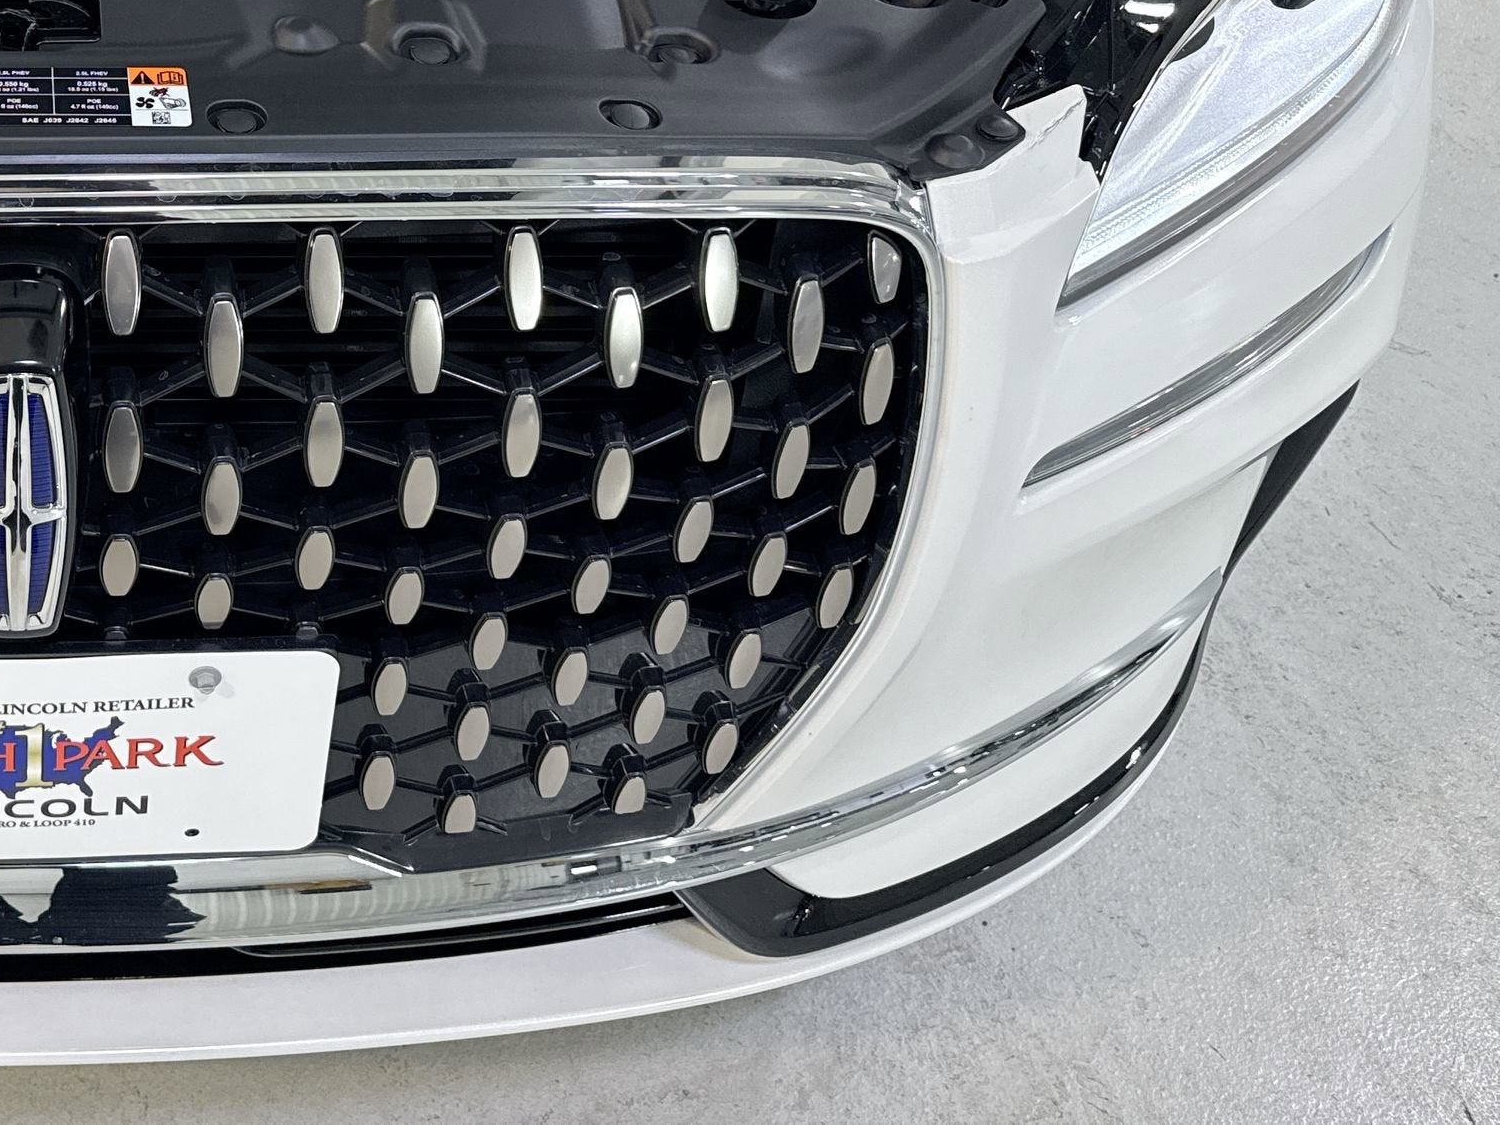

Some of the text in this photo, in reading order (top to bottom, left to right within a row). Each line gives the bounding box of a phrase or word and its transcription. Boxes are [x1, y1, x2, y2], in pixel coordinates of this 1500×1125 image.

[93, 696, 195, 713] RETAILER
[54, 734, 224, 770] PARK
[19, 820, 32, 828] &
[33, 819, 73, 828] LOOP
[73, 818, 96, 827] 410
